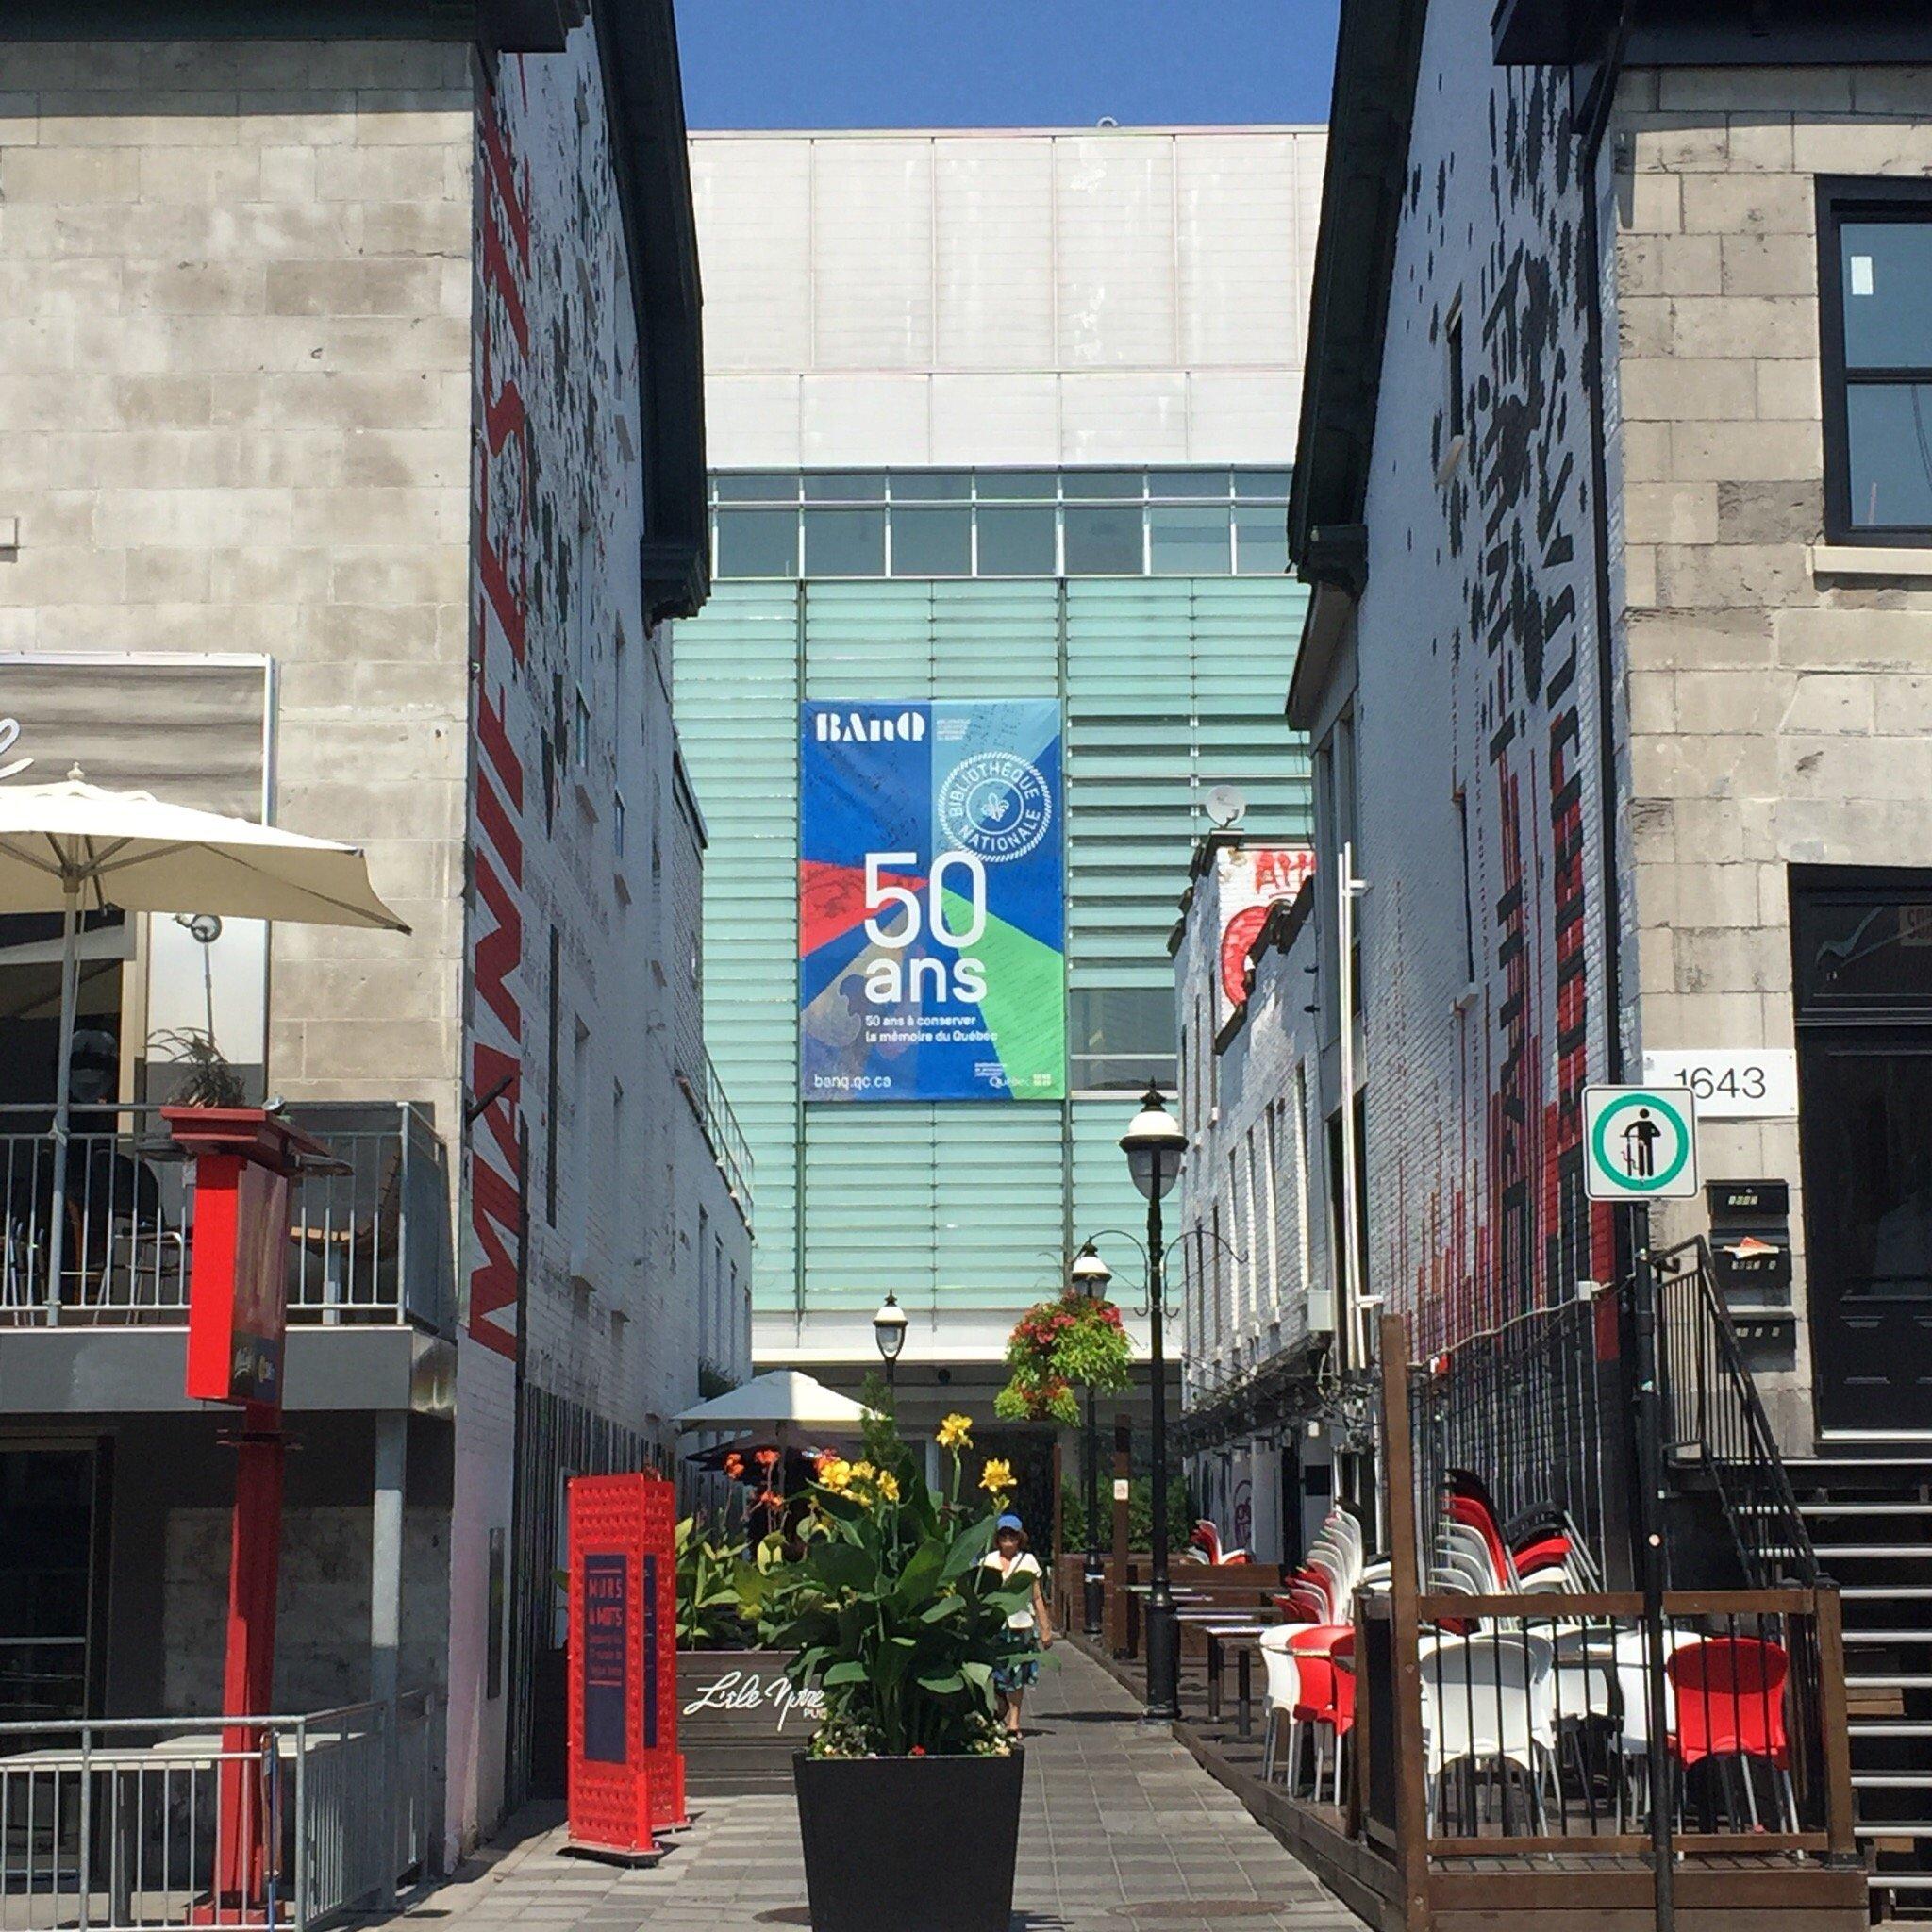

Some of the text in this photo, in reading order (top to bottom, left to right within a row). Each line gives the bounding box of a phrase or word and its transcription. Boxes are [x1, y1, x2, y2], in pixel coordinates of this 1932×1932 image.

[958, 808, 1041, 853] NATIONALE
[864, 851, 987, 949] 50
[864, 957, 988, 1004] ans
[865, 1015, 976, 1026] 50 ans à conserver
[865, 1030, 999, 1042] la mémoire du Québec
[814, 1074, 891, 1091] banq.qc.ca
[1674, 1067, 1766, 1099] 1643
